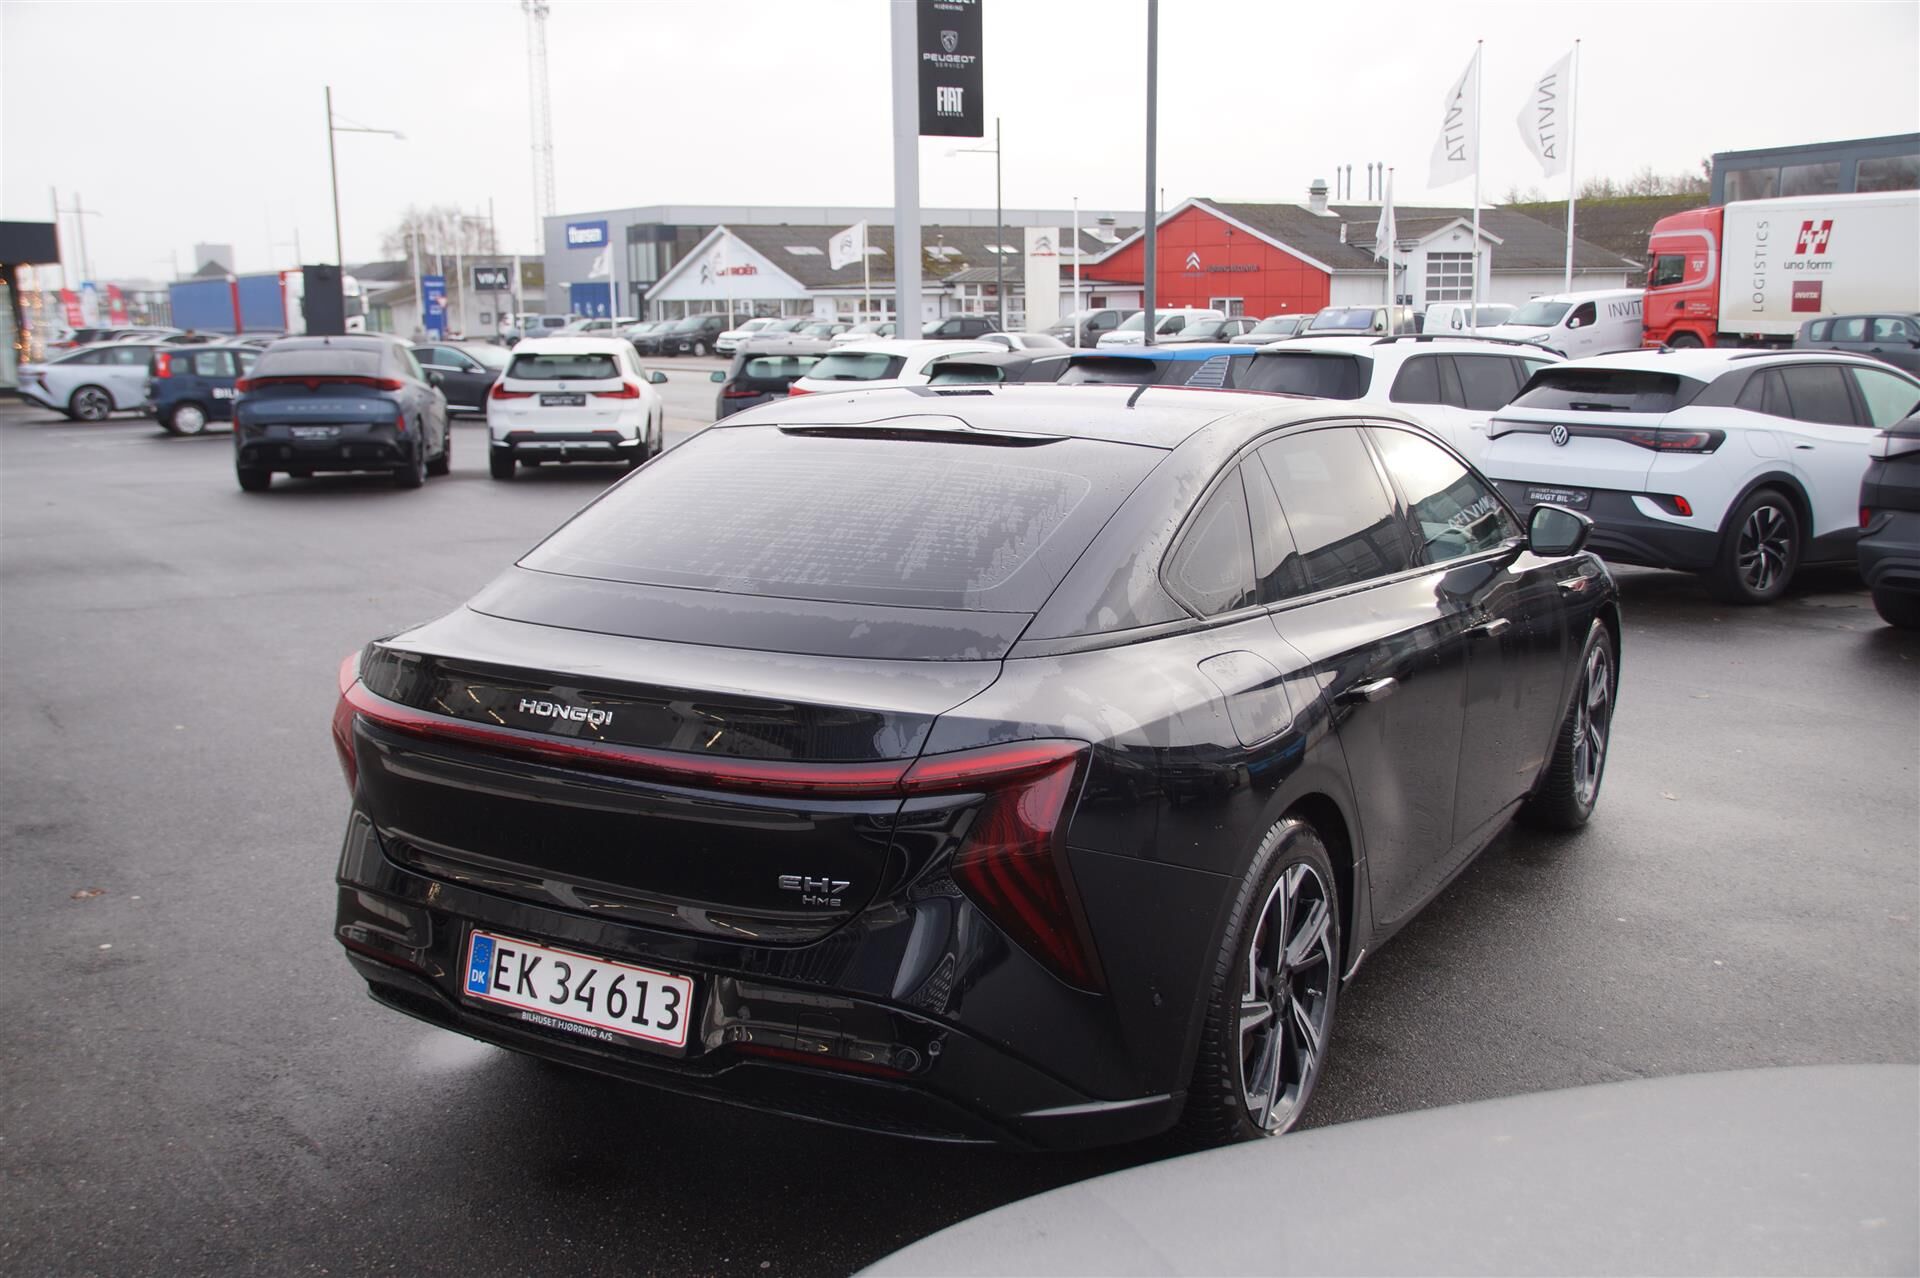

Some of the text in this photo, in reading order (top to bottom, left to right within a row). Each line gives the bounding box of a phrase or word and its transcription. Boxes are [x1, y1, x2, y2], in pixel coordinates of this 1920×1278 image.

[923, 53, 976, 64] PEUGEOT
[936, 86, 964, 113] FIAT
[1752, 220, 1769, 312] LOGISTICS
[1783, 259, 1833, 270] uno form
[1530, 492, 1556, 501] BRUGT
[519, 698, 613, 726] HONGQI
[778, 874, 850, 893] EH7
[802, 894, 841, 907] HME
[471, 969, 486, 985] DK
[521, 1011, 613, 1041] BILHUSET HJØRRING A/S
